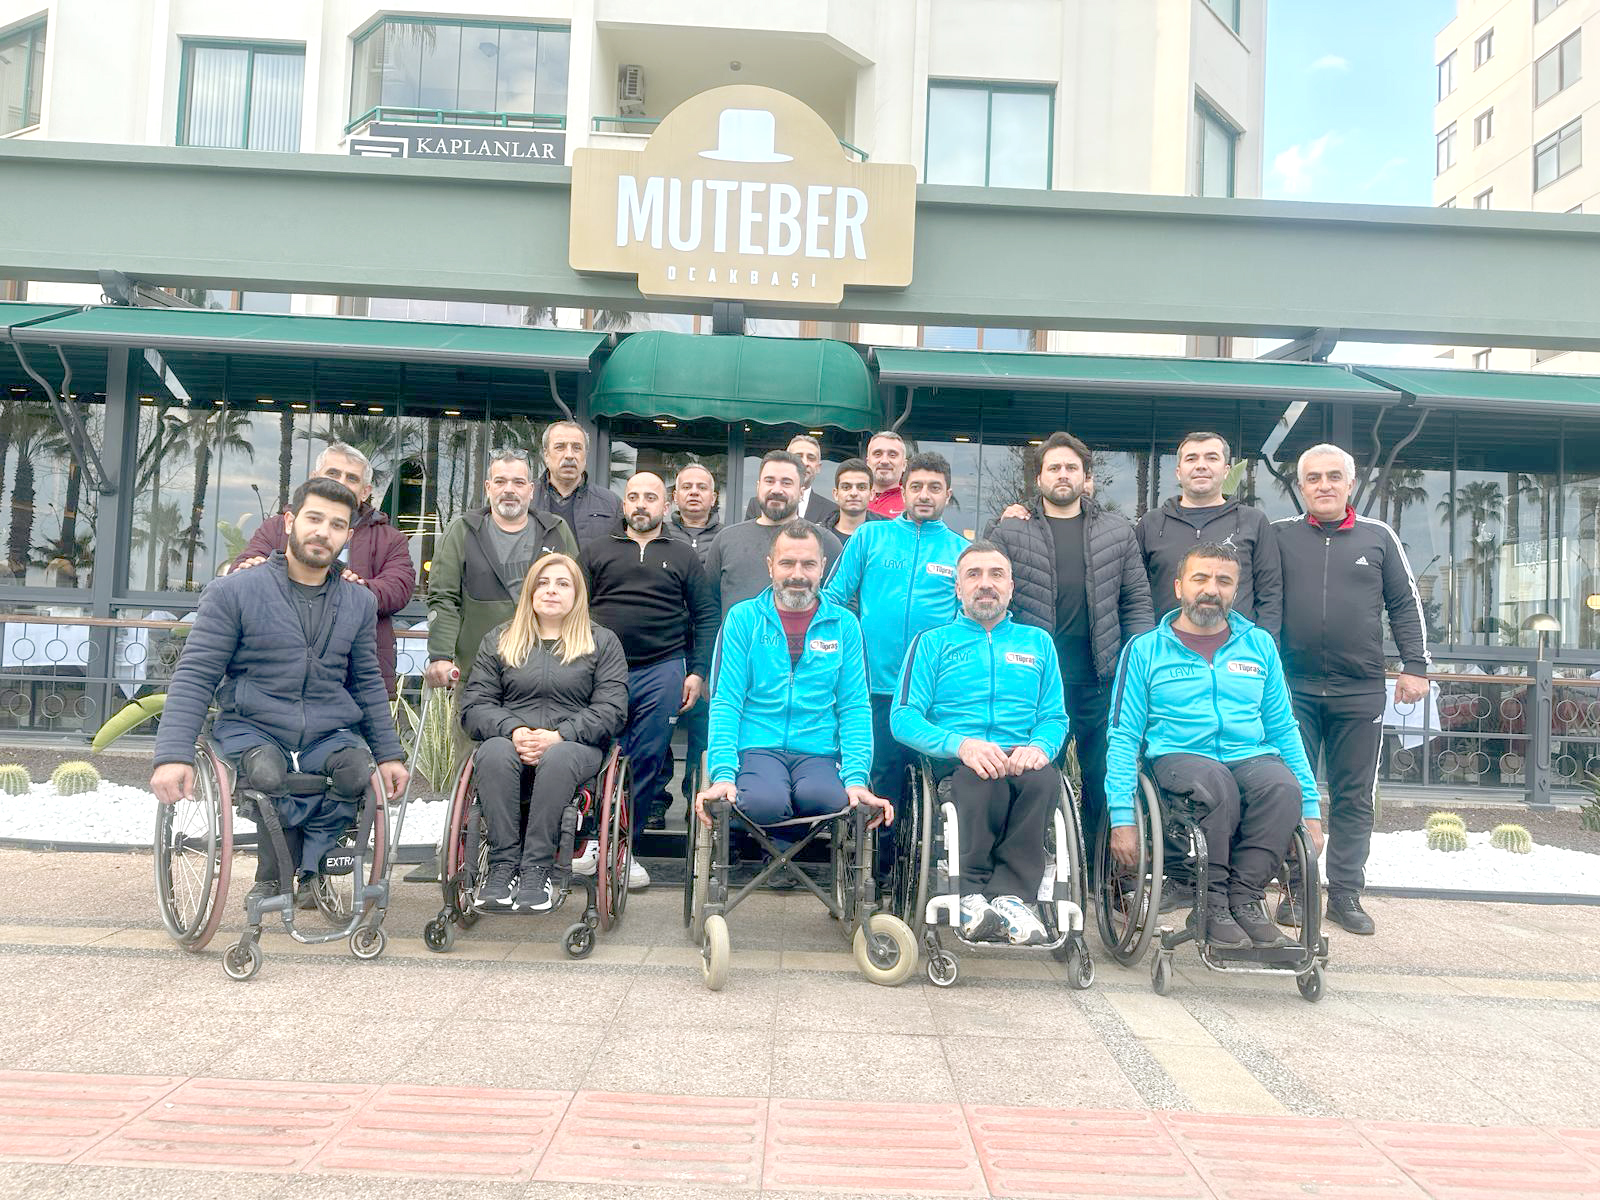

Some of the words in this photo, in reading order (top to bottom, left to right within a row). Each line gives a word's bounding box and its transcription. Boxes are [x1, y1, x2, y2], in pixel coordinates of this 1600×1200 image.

[416, 137, 556, 159] KAPLANLAR
[616, 175, 869, 260] MUTEBER
[667, 266, 817, 288] OCAKBAŞI
